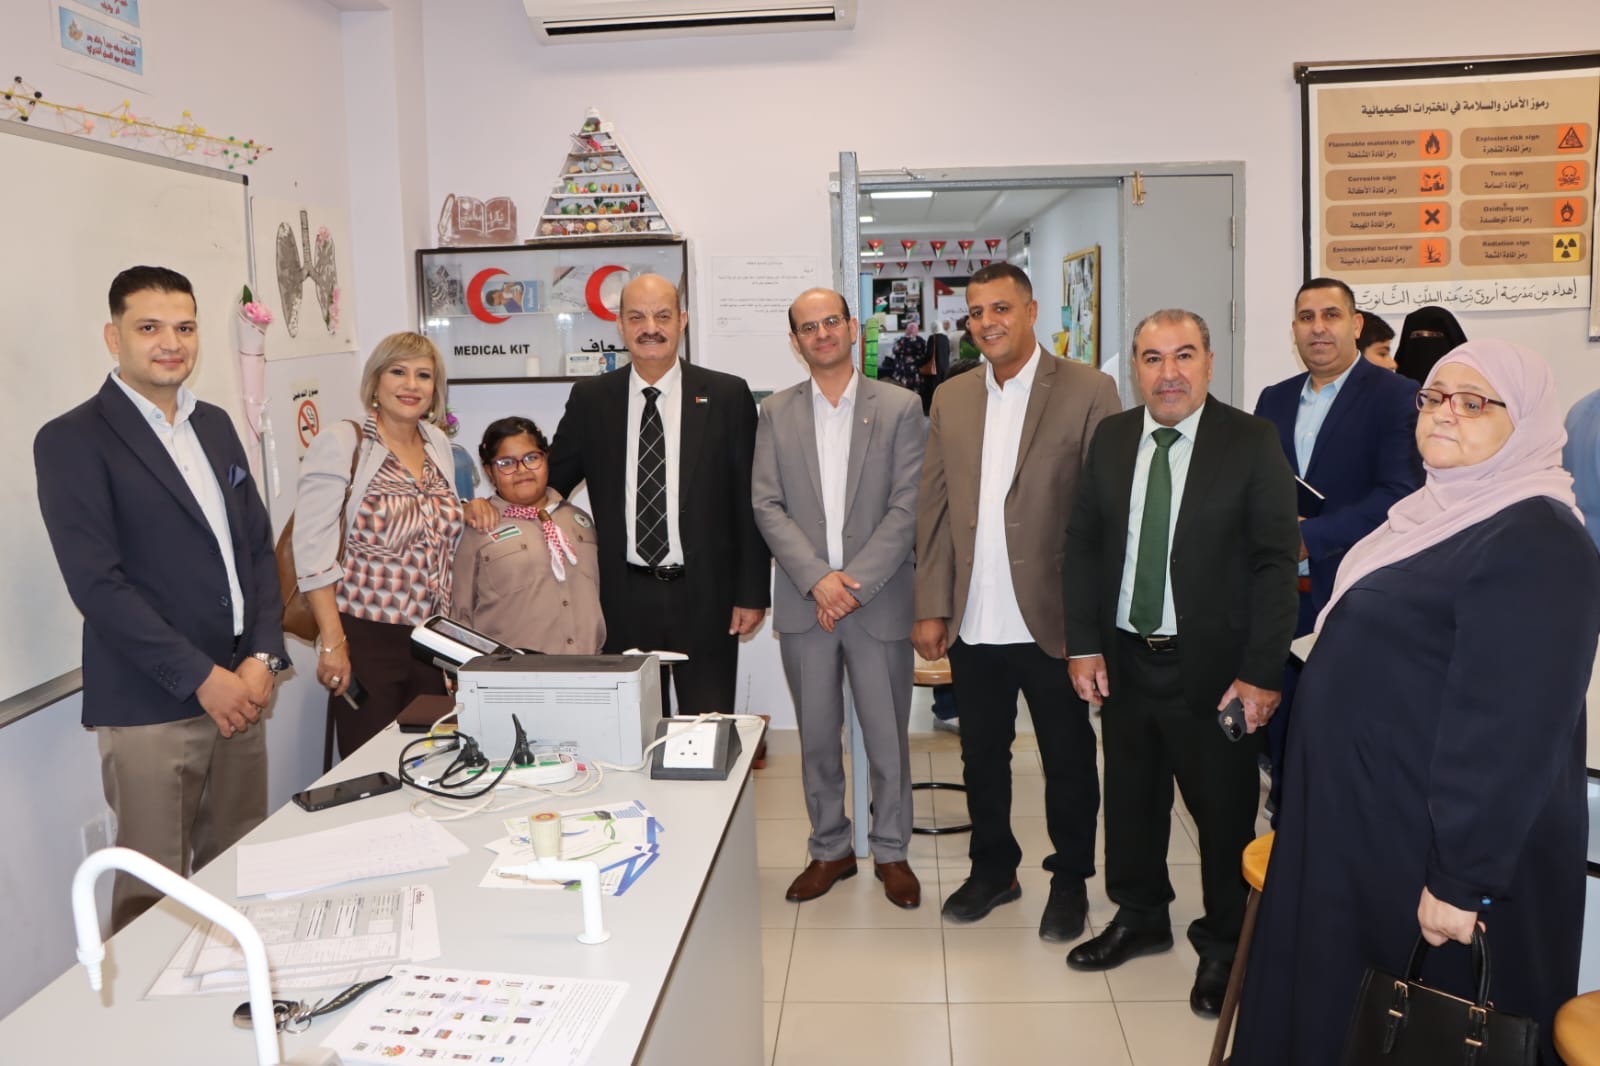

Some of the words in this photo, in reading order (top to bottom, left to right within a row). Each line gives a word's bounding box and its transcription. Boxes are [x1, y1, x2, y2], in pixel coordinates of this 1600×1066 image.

[1361, 103, 1412, 118] الكيميائية
[1413, 101, 1449, 116] المختبرات
[1449, 99, 1462, 116] في
[1463, 99, 1501, 113] والسلامة
[1503, 96, 1529, 112] الأمان
[1530, 97, 1550, 112] رموز
[1524, 133, 1541, 142] sign
[1508, 170, 1524, 178] sign
[1515, 239, 1530, 247] sign
[454, 345, 506, 356] MEDICAL
[509, 344, 530, 355] KIT
